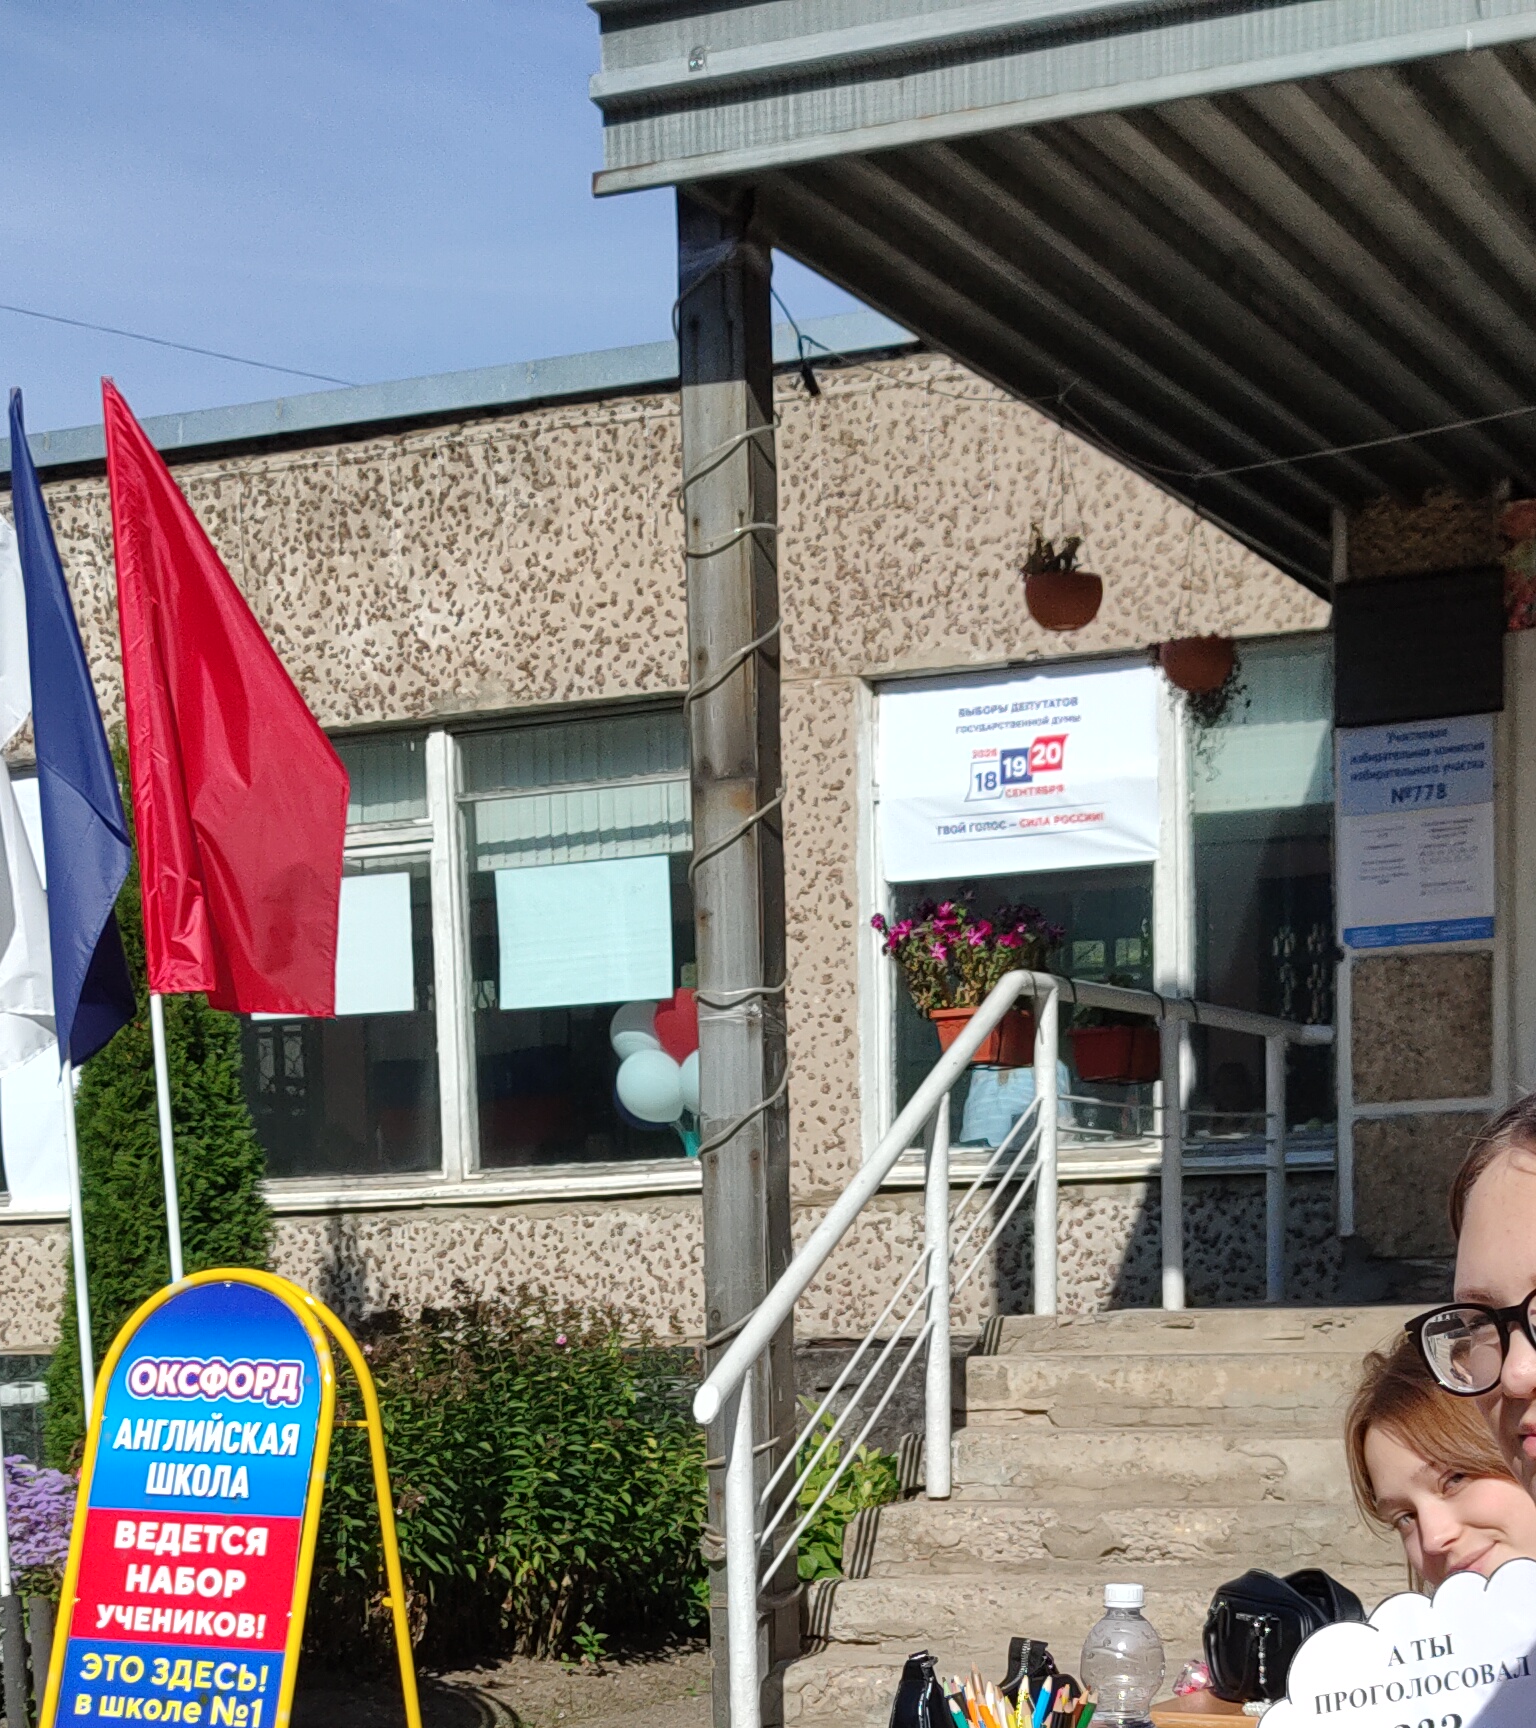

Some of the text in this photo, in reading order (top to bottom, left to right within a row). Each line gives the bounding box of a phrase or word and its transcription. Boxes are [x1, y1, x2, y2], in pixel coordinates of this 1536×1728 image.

[956, 716, 1049, 733] ГОСУДАРСТВЕННОЙ
[958, 696, 1079, 718] ВЫБОРЫ ДЕПУТАТОВ
[975, 742, 1062, 792] 18 19 20
[1005, 784, 1064, 798] СЕНТЯБРЯ
[1391, 782, 1448, 804] №778
[937, 821, 967, 837] ТВОЙ
[969, 820, 1008, 834] ГОЛОС
[1019, 816, 1051, 829] СИЛА
[129, 1359, 302, 1404] ОКСФОРД
[112, 1412, 301, 1456] АНГЛИЙСКАЯ
[145, 1461, 250, 1499] ШКОЛА
[114, 1519, 269, 1558] ВЕДЕТСЯ
[124, 1563, 247, 1599] НАБОР
[95, 1603, 267, 1640] УЧЕНИКОВ!
[1387, 1633, 1455, 1667] А ТЫ
[79, 1652, 270, 1693] ЭТО ЗДЕСЬ!
[1314, 1654, 1532, 1715] ПРОГОЛОСОВАЛ
[98, 1695, 202, 1724] школе
[209, 1695, 264, 1728] №1
